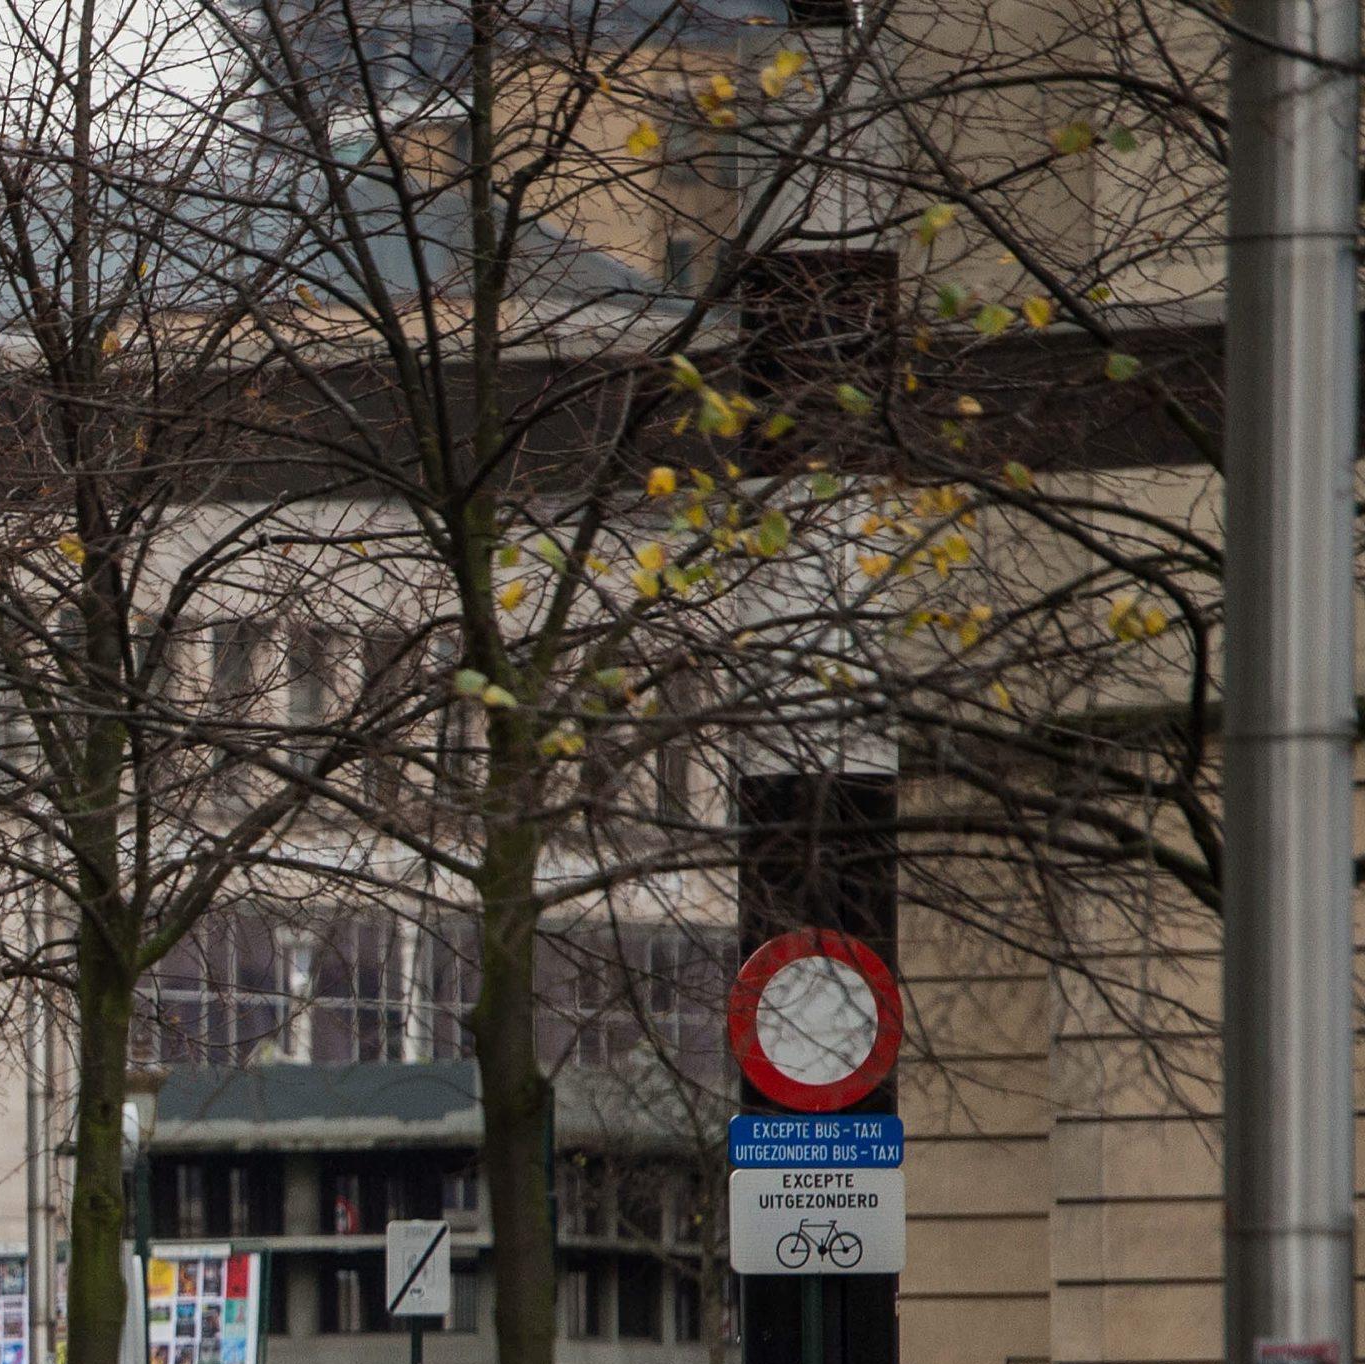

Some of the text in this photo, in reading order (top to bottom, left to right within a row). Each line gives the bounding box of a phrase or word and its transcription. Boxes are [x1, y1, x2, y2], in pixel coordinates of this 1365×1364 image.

[753, 1122, 810, 1139] EXCEPTE
[815, 1122, 840, 1139] BUS
[853, 1122, 882, 1139] TAXI
[735, 1145, 827, 1161] UITGEZONDERD
[833, 1145, 858, 1161] BUS
[871, 1145, 899, 1161] TAXI
[783, 1173, 855, 1189] EXCEPTE
[759, 1193, 879, 1209] UITGEZONDERD
